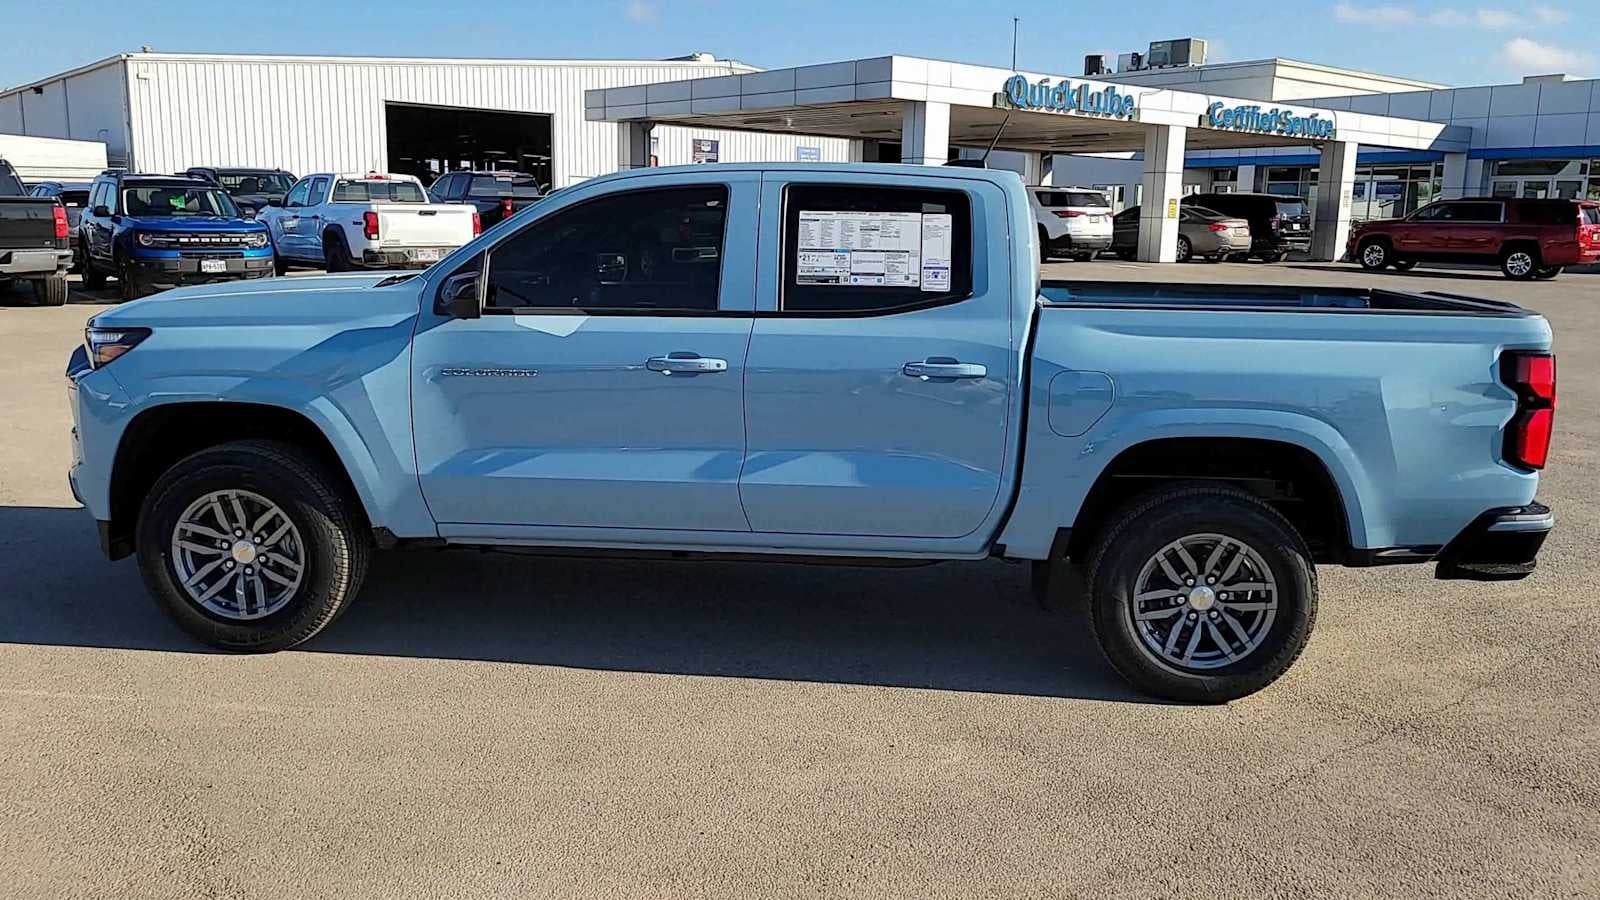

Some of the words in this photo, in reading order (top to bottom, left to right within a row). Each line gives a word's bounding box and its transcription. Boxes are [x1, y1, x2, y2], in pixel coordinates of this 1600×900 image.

[1005, 74, 1076, 110] Quick
[1078, 83, 1134, 116] Lube
[1209, 101, 1279, 131] Certified
[1281, 110, 1333, 137] Service
[440, 368, 538, 377] COLORADO
